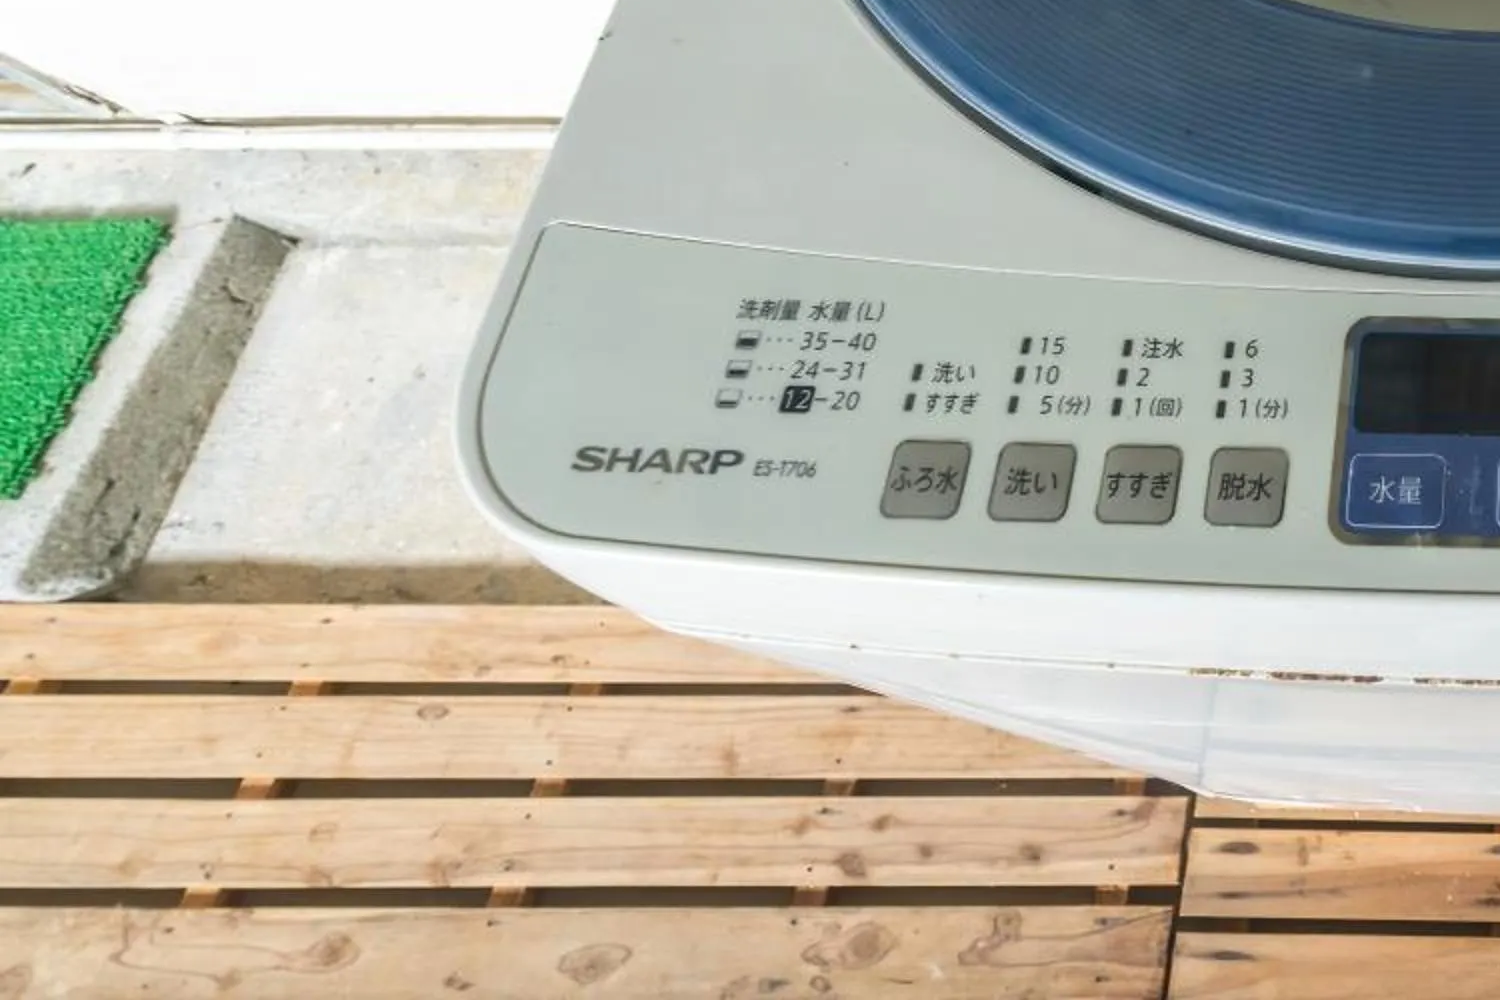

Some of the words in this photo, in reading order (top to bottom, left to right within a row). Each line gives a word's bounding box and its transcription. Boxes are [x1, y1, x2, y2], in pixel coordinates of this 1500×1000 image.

[736, 299, 801, 320] 洗剤量
[1040, 336, 1067, 356] 15
[1141, 337, 1185, 358] 注水
[1245, 340, 1259, 358] 6
[931, 362, 976, 383] 洗い
[1035, 365, 1061, 384] 10
[1136, 367, 1150, 386] 2
[1241, 369, 1254, 387] 3
[926, 391, 981, 415] すすぎ
[570, 445, 746, 475] SHARP
[891, 466, 959, 494] ふろ水
[1004, 467, 1058, 494] 洗い
[1107, 471, 1174, 499] すすぎ
[1217, 473, 1273, 501] 脱水
[1369, 475, 1423, 505] 水量
